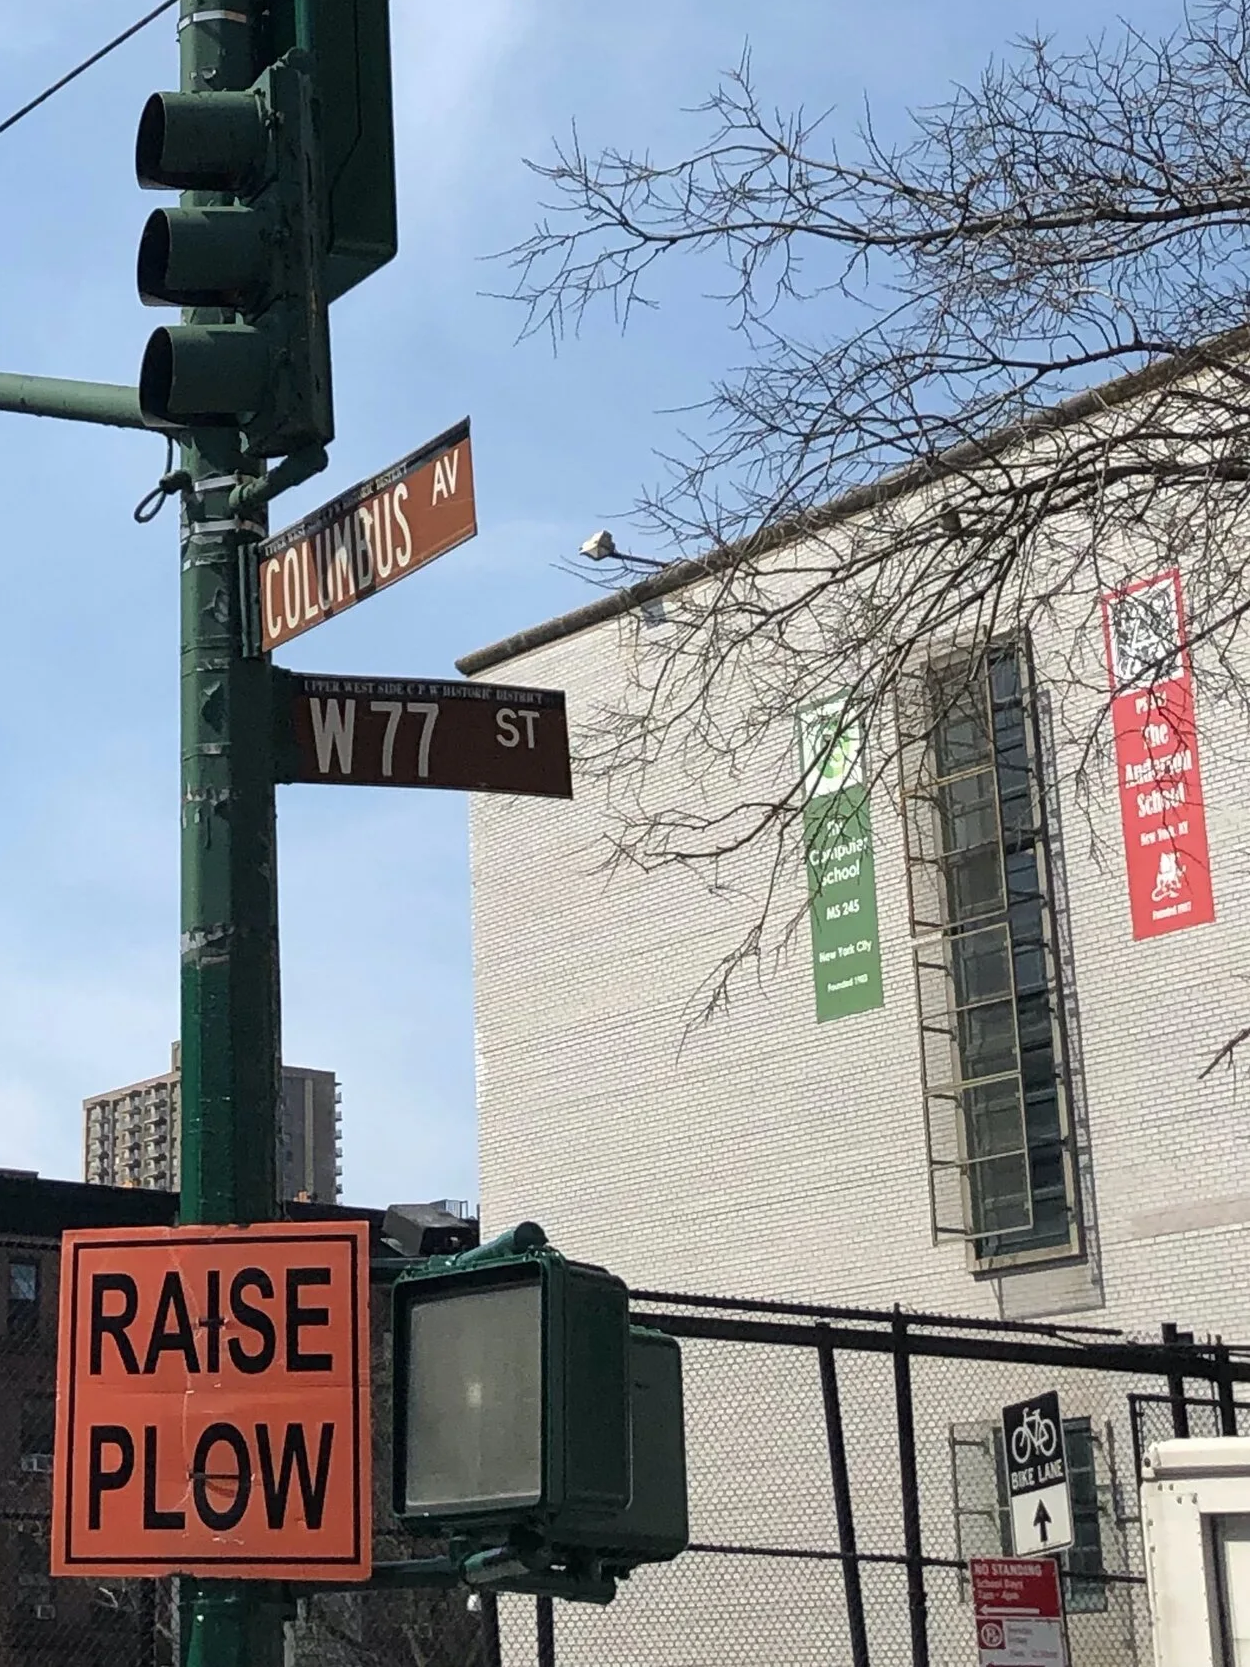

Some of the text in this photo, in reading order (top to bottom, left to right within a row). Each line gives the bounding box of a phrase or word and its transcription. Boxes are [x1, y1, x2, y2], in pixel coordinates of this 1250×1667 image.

[266, 482, 412, 639] COLUMBUS
[432, 448, 459, 507] AV
[309, 697, 540, 778] W 77 ST
[826, 898, 860, 920] MS 245
[819, 939, 872, 963] New York City
[89, 1268, 333, 1376] RAISE
[88, 1422, 336, 1531] PLOW
[1011, 1458, 1064, 1491] BIKE LANE
[974, 1563, 1043, 1578] NO STANDING
